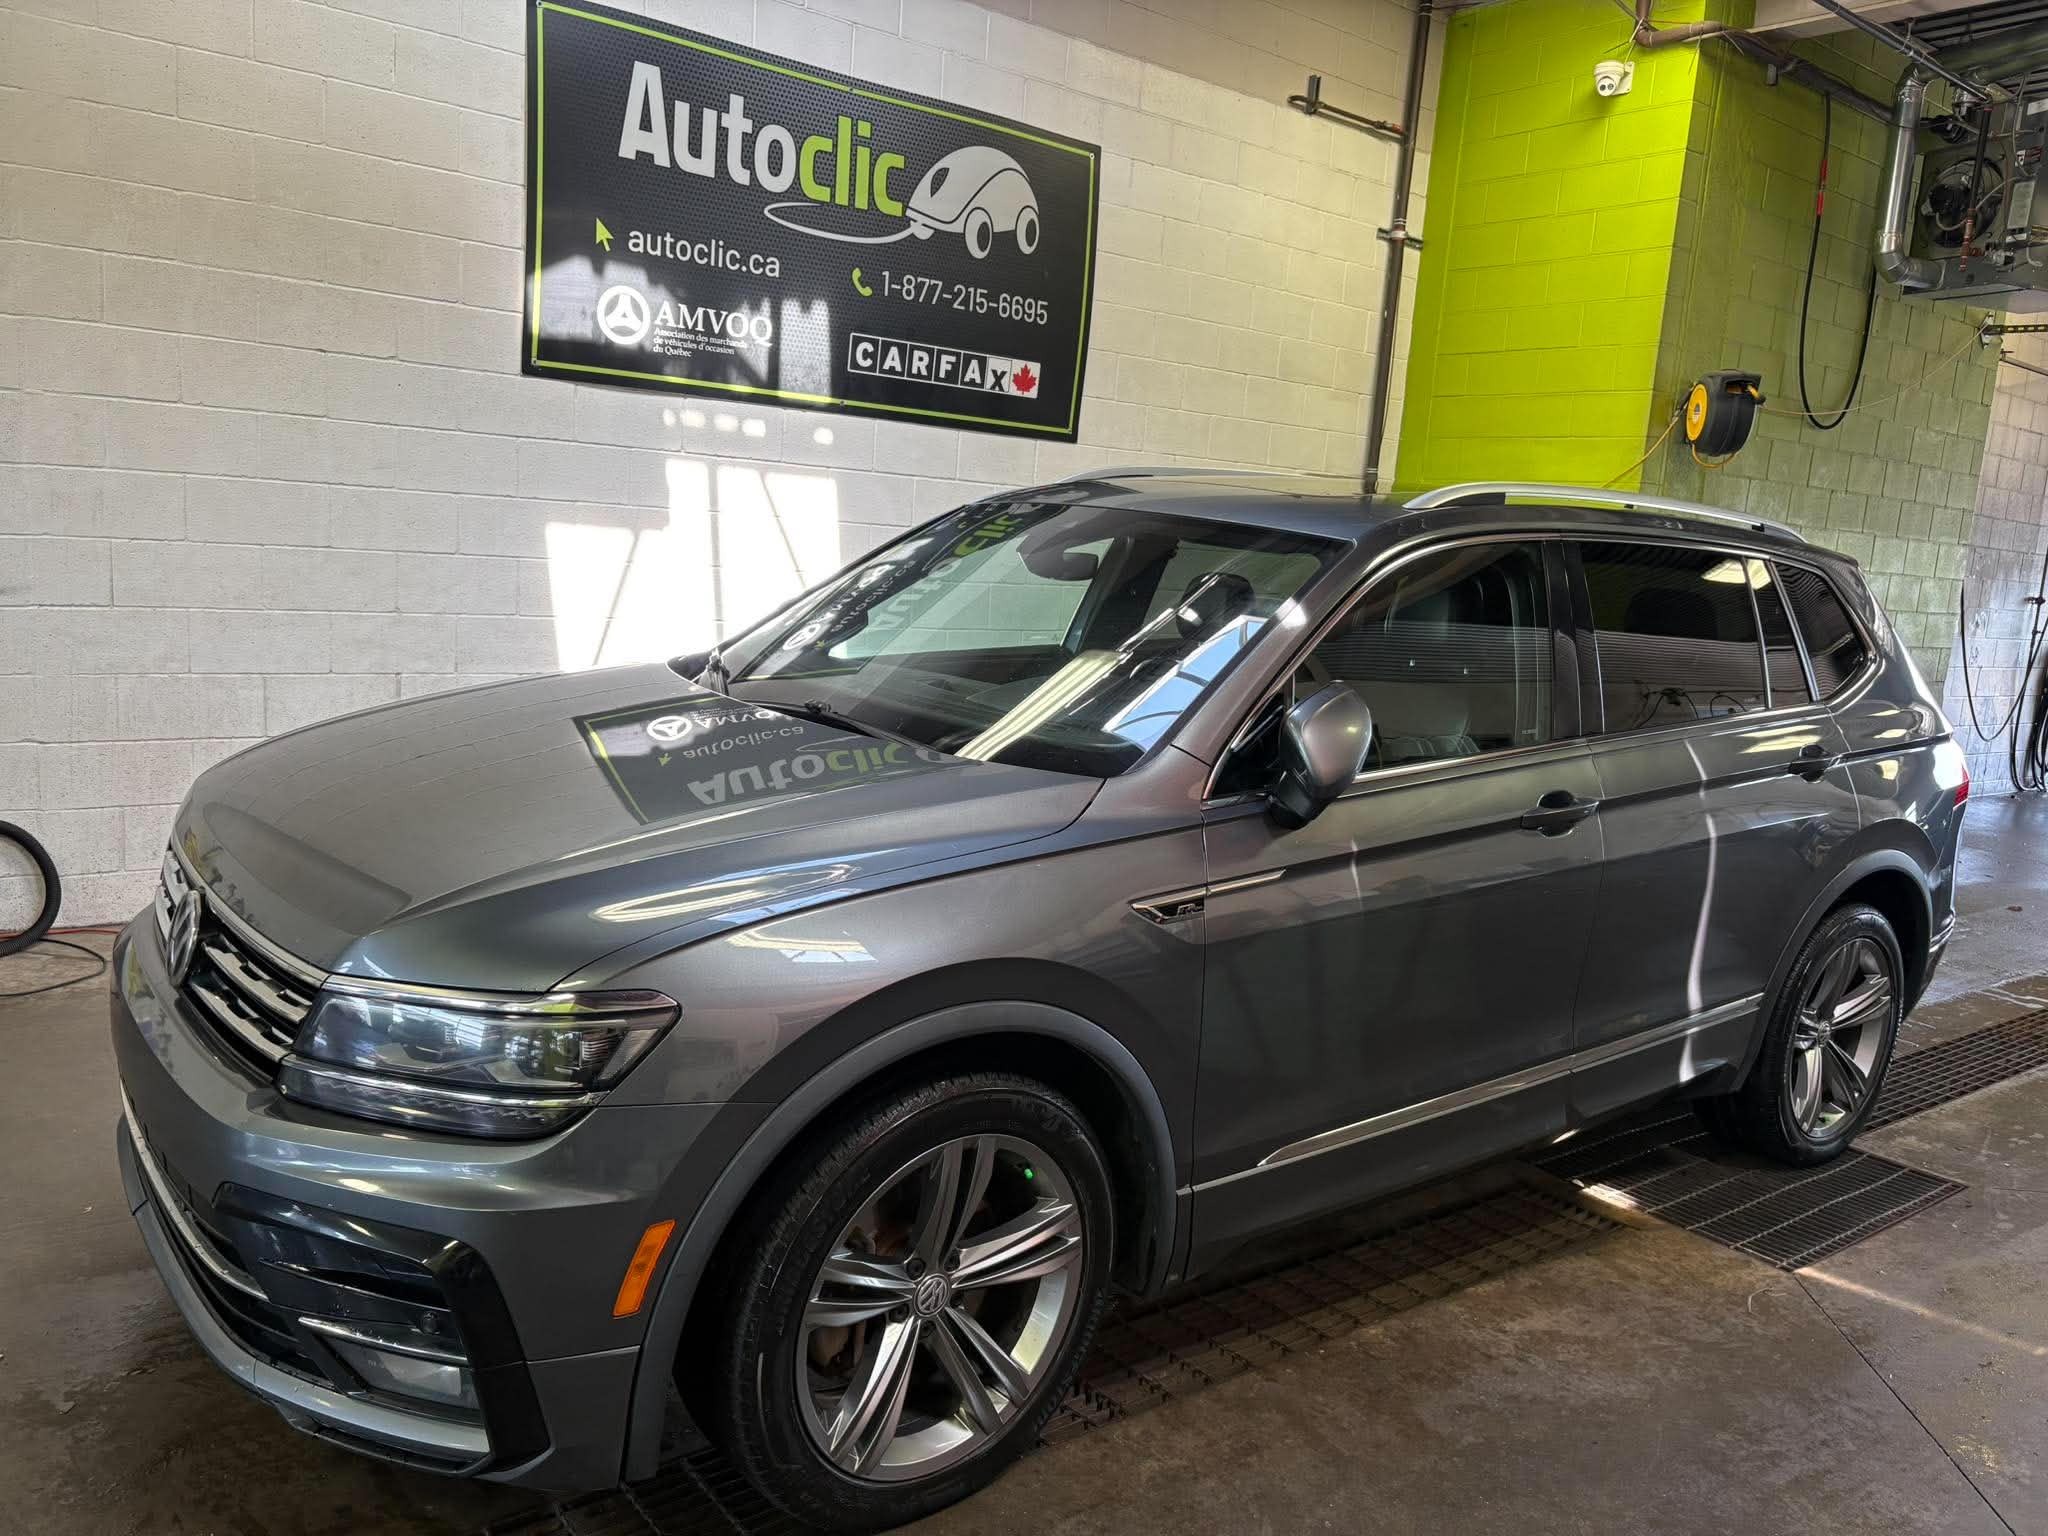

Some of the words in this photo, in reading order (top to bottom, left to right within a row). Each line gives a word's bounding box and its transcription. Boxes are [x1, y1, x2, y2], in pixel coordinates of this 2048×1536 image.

[617, 60, 906, 218] Autoclic
[627, 225, 781, 279] autoclic.ca
[654, 299, 773, 348] AMVOQ
[881, 270, 1049, 326] 1-877-215-6695
[653, 327, 695, 341] Association
[696, 332, 709, 343] des
[709, 337, 747, 348] marchands
[653, 336, 664, 344] de
[664, 337, 697, 350] véhicules
[698, 343, 735, 355] d'occasion
[653, 344, 664, 353] du
[664, 345, 692, 357] Québec
[854, 340, 1009, 393] CARFAX
